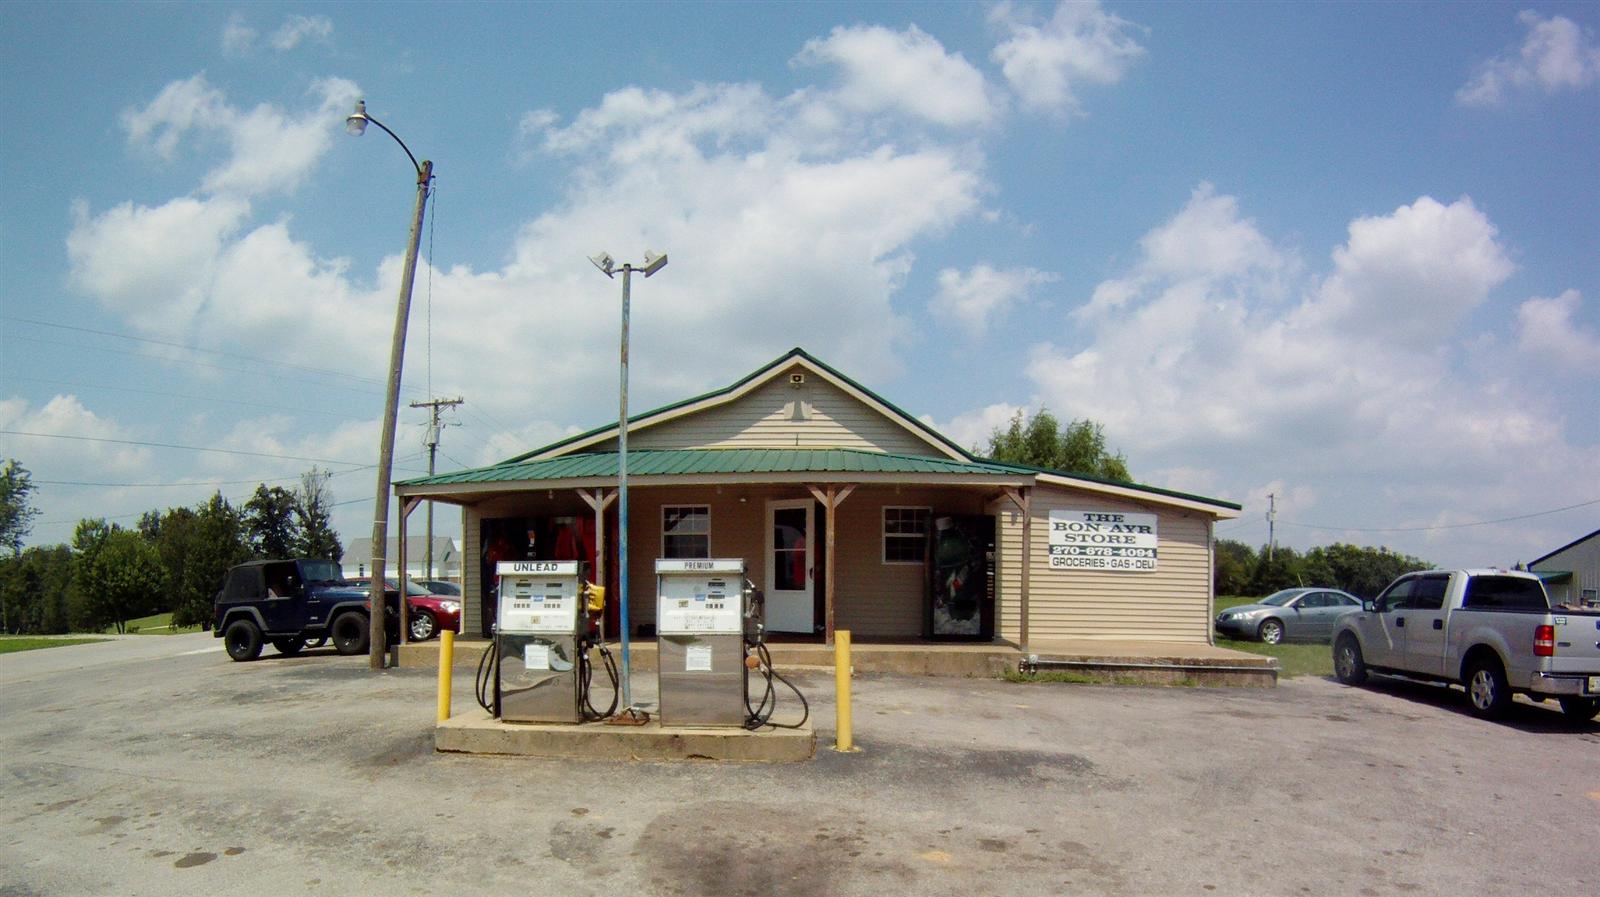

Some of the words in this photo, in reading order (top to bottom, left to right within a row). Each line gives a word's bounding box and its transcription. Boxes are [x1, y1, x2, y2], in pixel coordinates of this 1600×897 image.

[1083, 513, 1125, 523] THE
[1053, 522, 1153, 534] BON-AYR
[1064, 533, 1136, 545] STORE
[1052, 545, 1154, 558] 270-678-4094
[513, 563, 558, 572] UNLEAD
[684, 562, 714, 570] PREMIUM
[1052, 557, 1105, 568] GROCERIES
[1110, 559, 1130, 569] GAS
[1135, 559, 1154, 569] DELI
